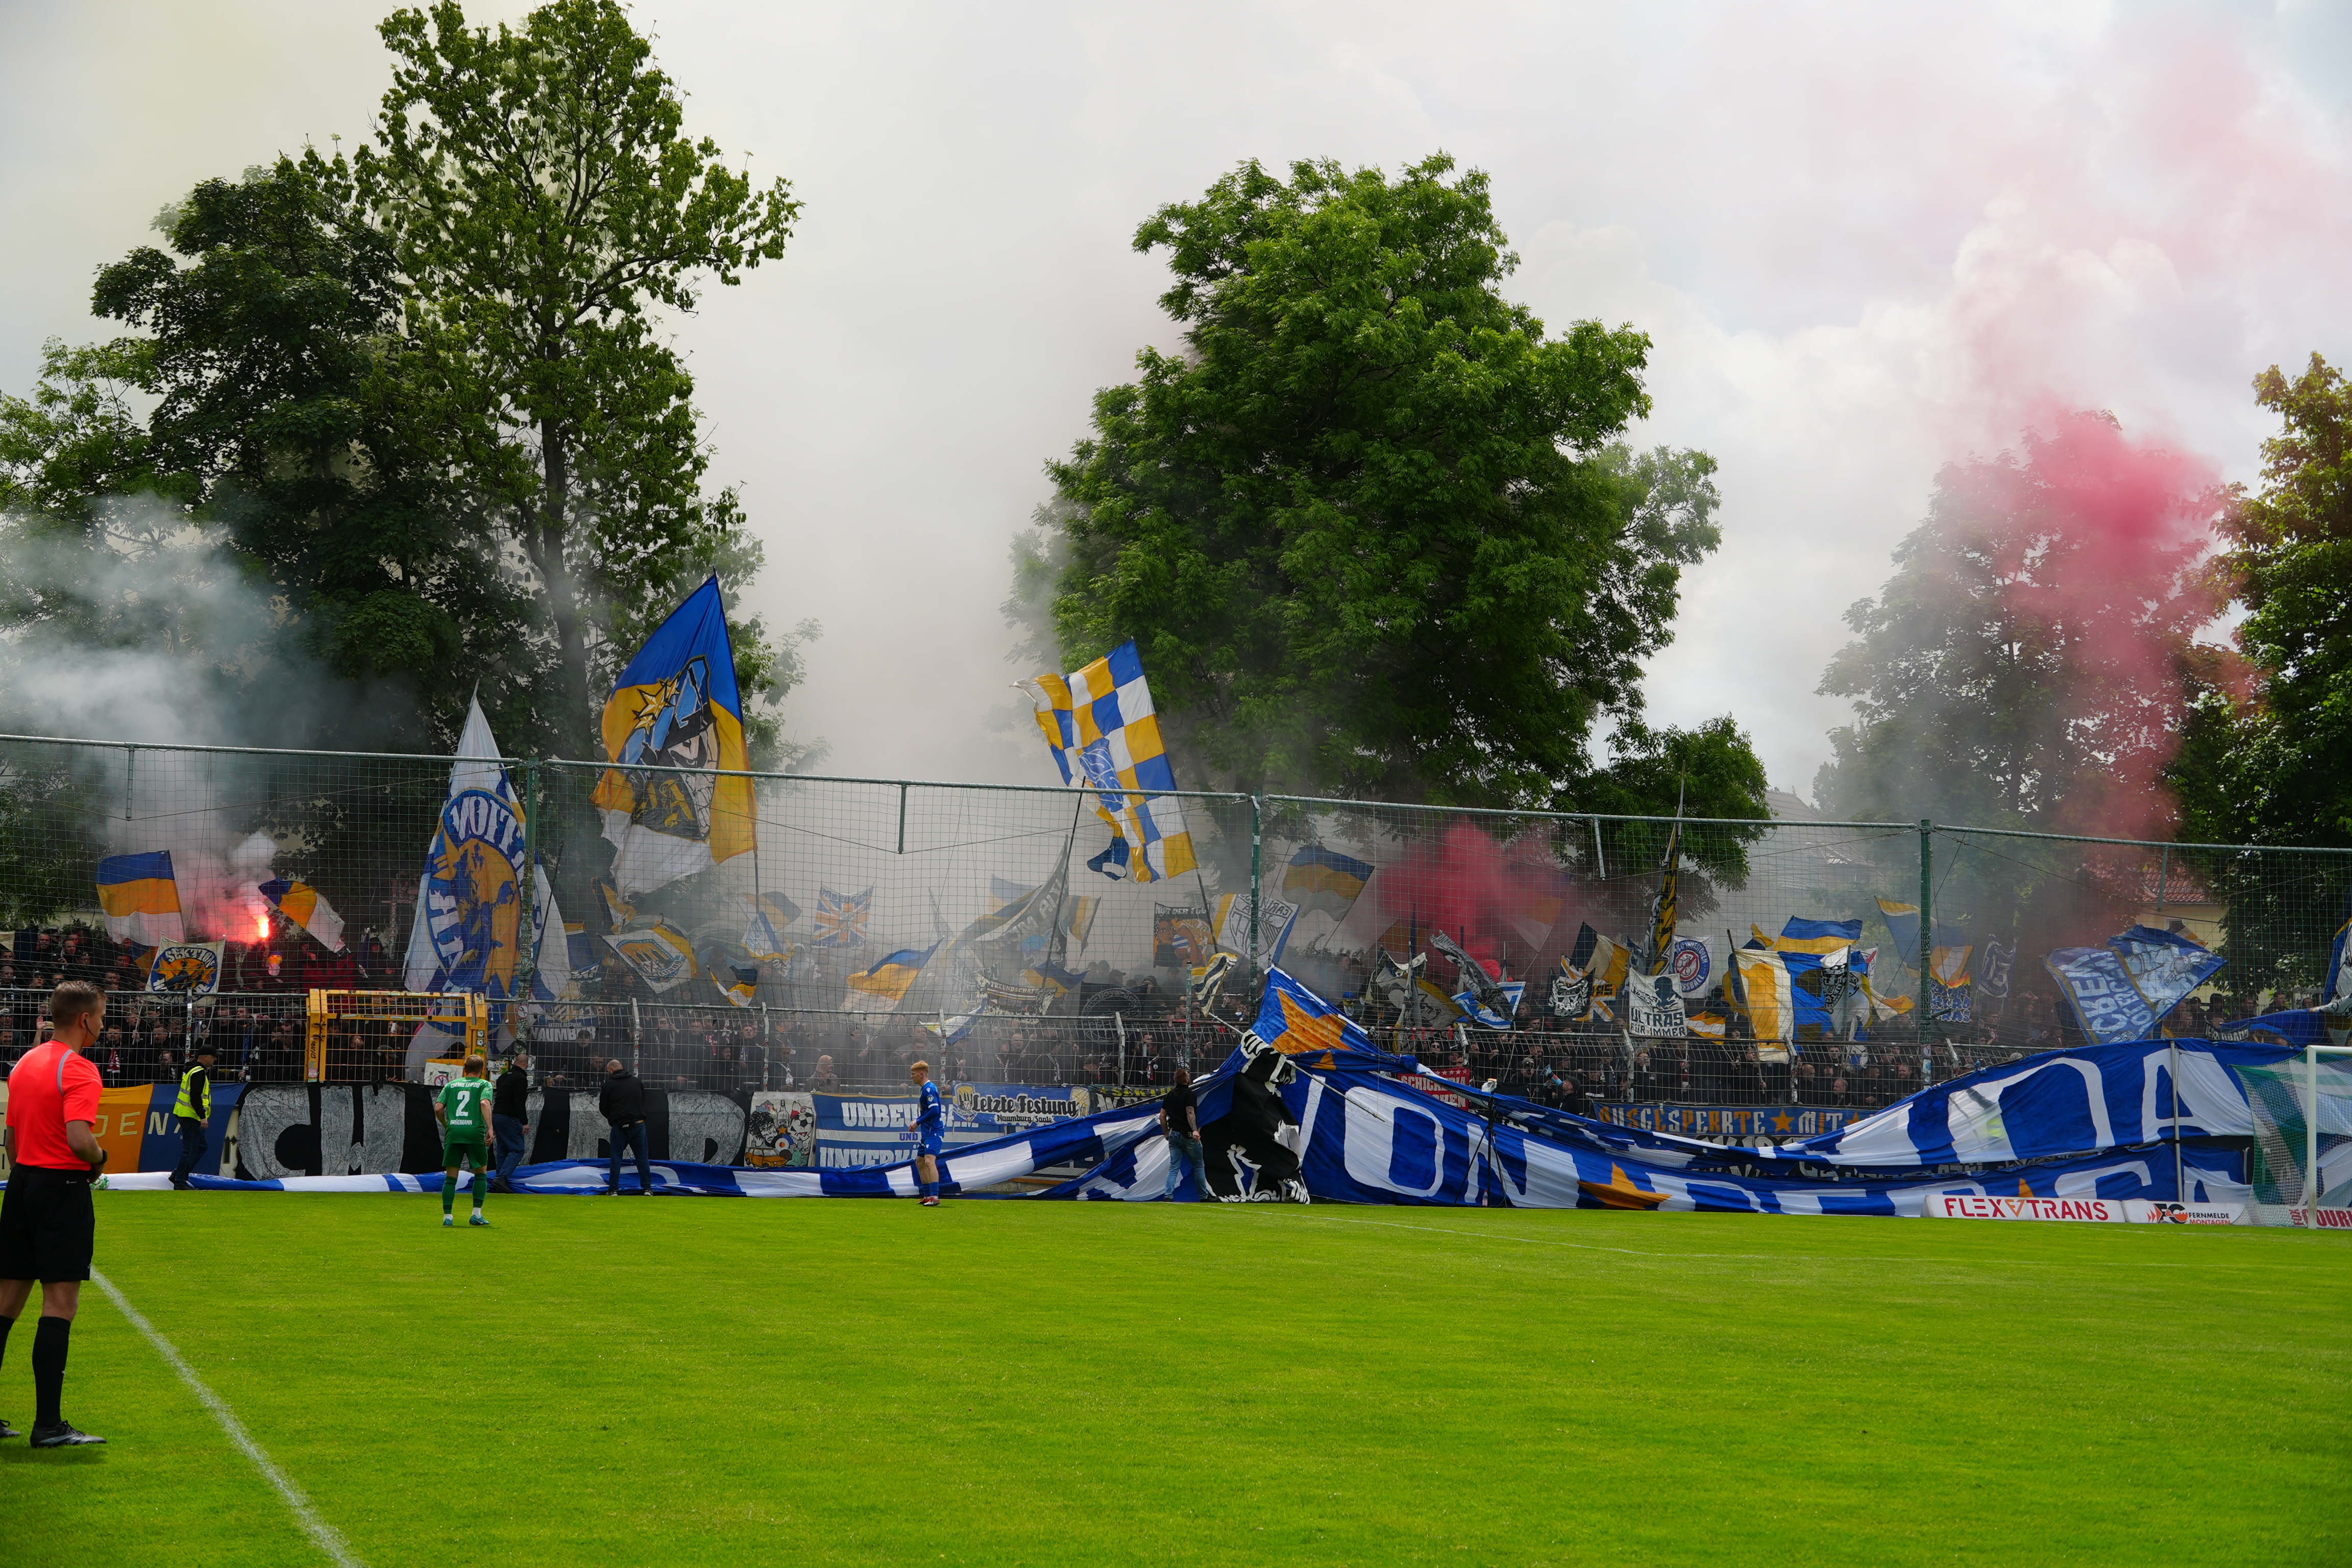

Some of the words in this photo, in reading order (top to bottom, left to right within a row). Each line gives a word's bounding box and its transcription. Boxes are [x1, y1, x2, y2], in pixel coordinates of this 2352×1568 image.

[165, 948, 215, 968] SEKTION
[1685, 941, 1708, 964] INVESTOREN
[1630, 1007, 1684, 1027] ULTRAS
[1630, 1022, 1646, 1035] FÜR
[1650, 1027, 1687, 1037] IMMER
[456, 1090, 470, 1117] 2
[972, 1092, 1015, 1114] Letzte
[1017, 1095, 1078, 1117] Festung
[95, 1111, 184, 1139] JEN
[1599, 1106, 1766, 1134] AUSGESPERRTE
[1799, 1112, 1843, 1134] MIT
[899, 1132, 919, 1141] UND
[1944, 1198, 2006, 1218] FLEX
[2026, 1199, 2109, 1221] TRANS
